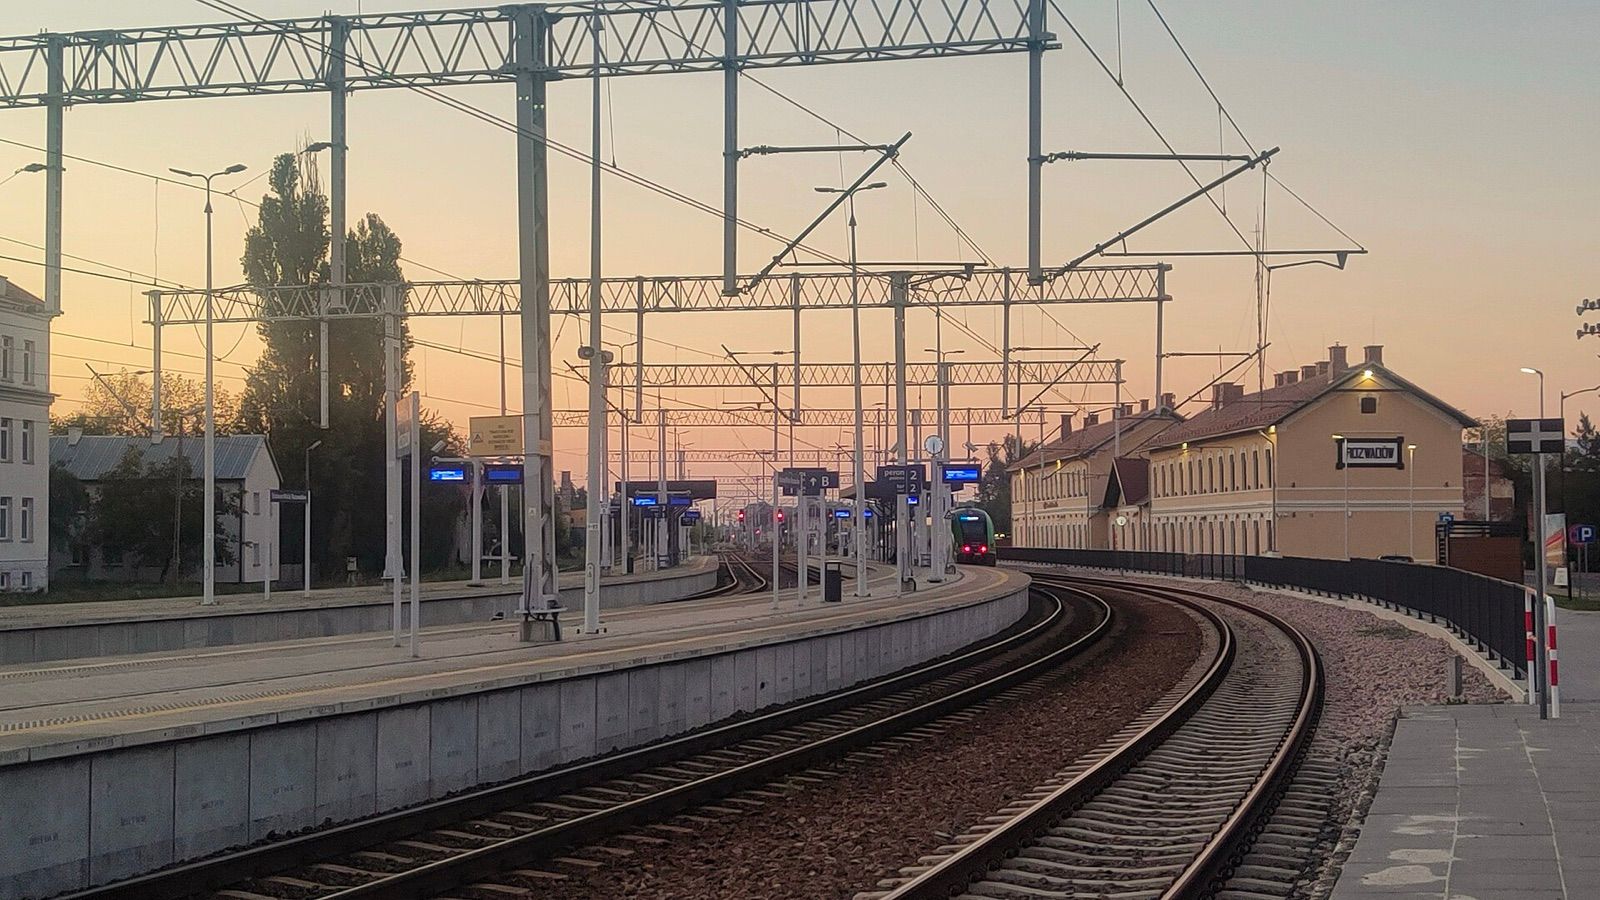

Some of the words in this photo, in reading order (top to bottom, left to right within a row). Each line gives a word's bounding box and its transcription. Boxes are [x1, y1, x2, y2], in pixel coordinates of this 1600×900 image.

[909, 470, 918, 480] 2
[821, 476, 830, 487] B
[909, 484, 916, 493] 2
[1581, 527, 1592, 541] P
